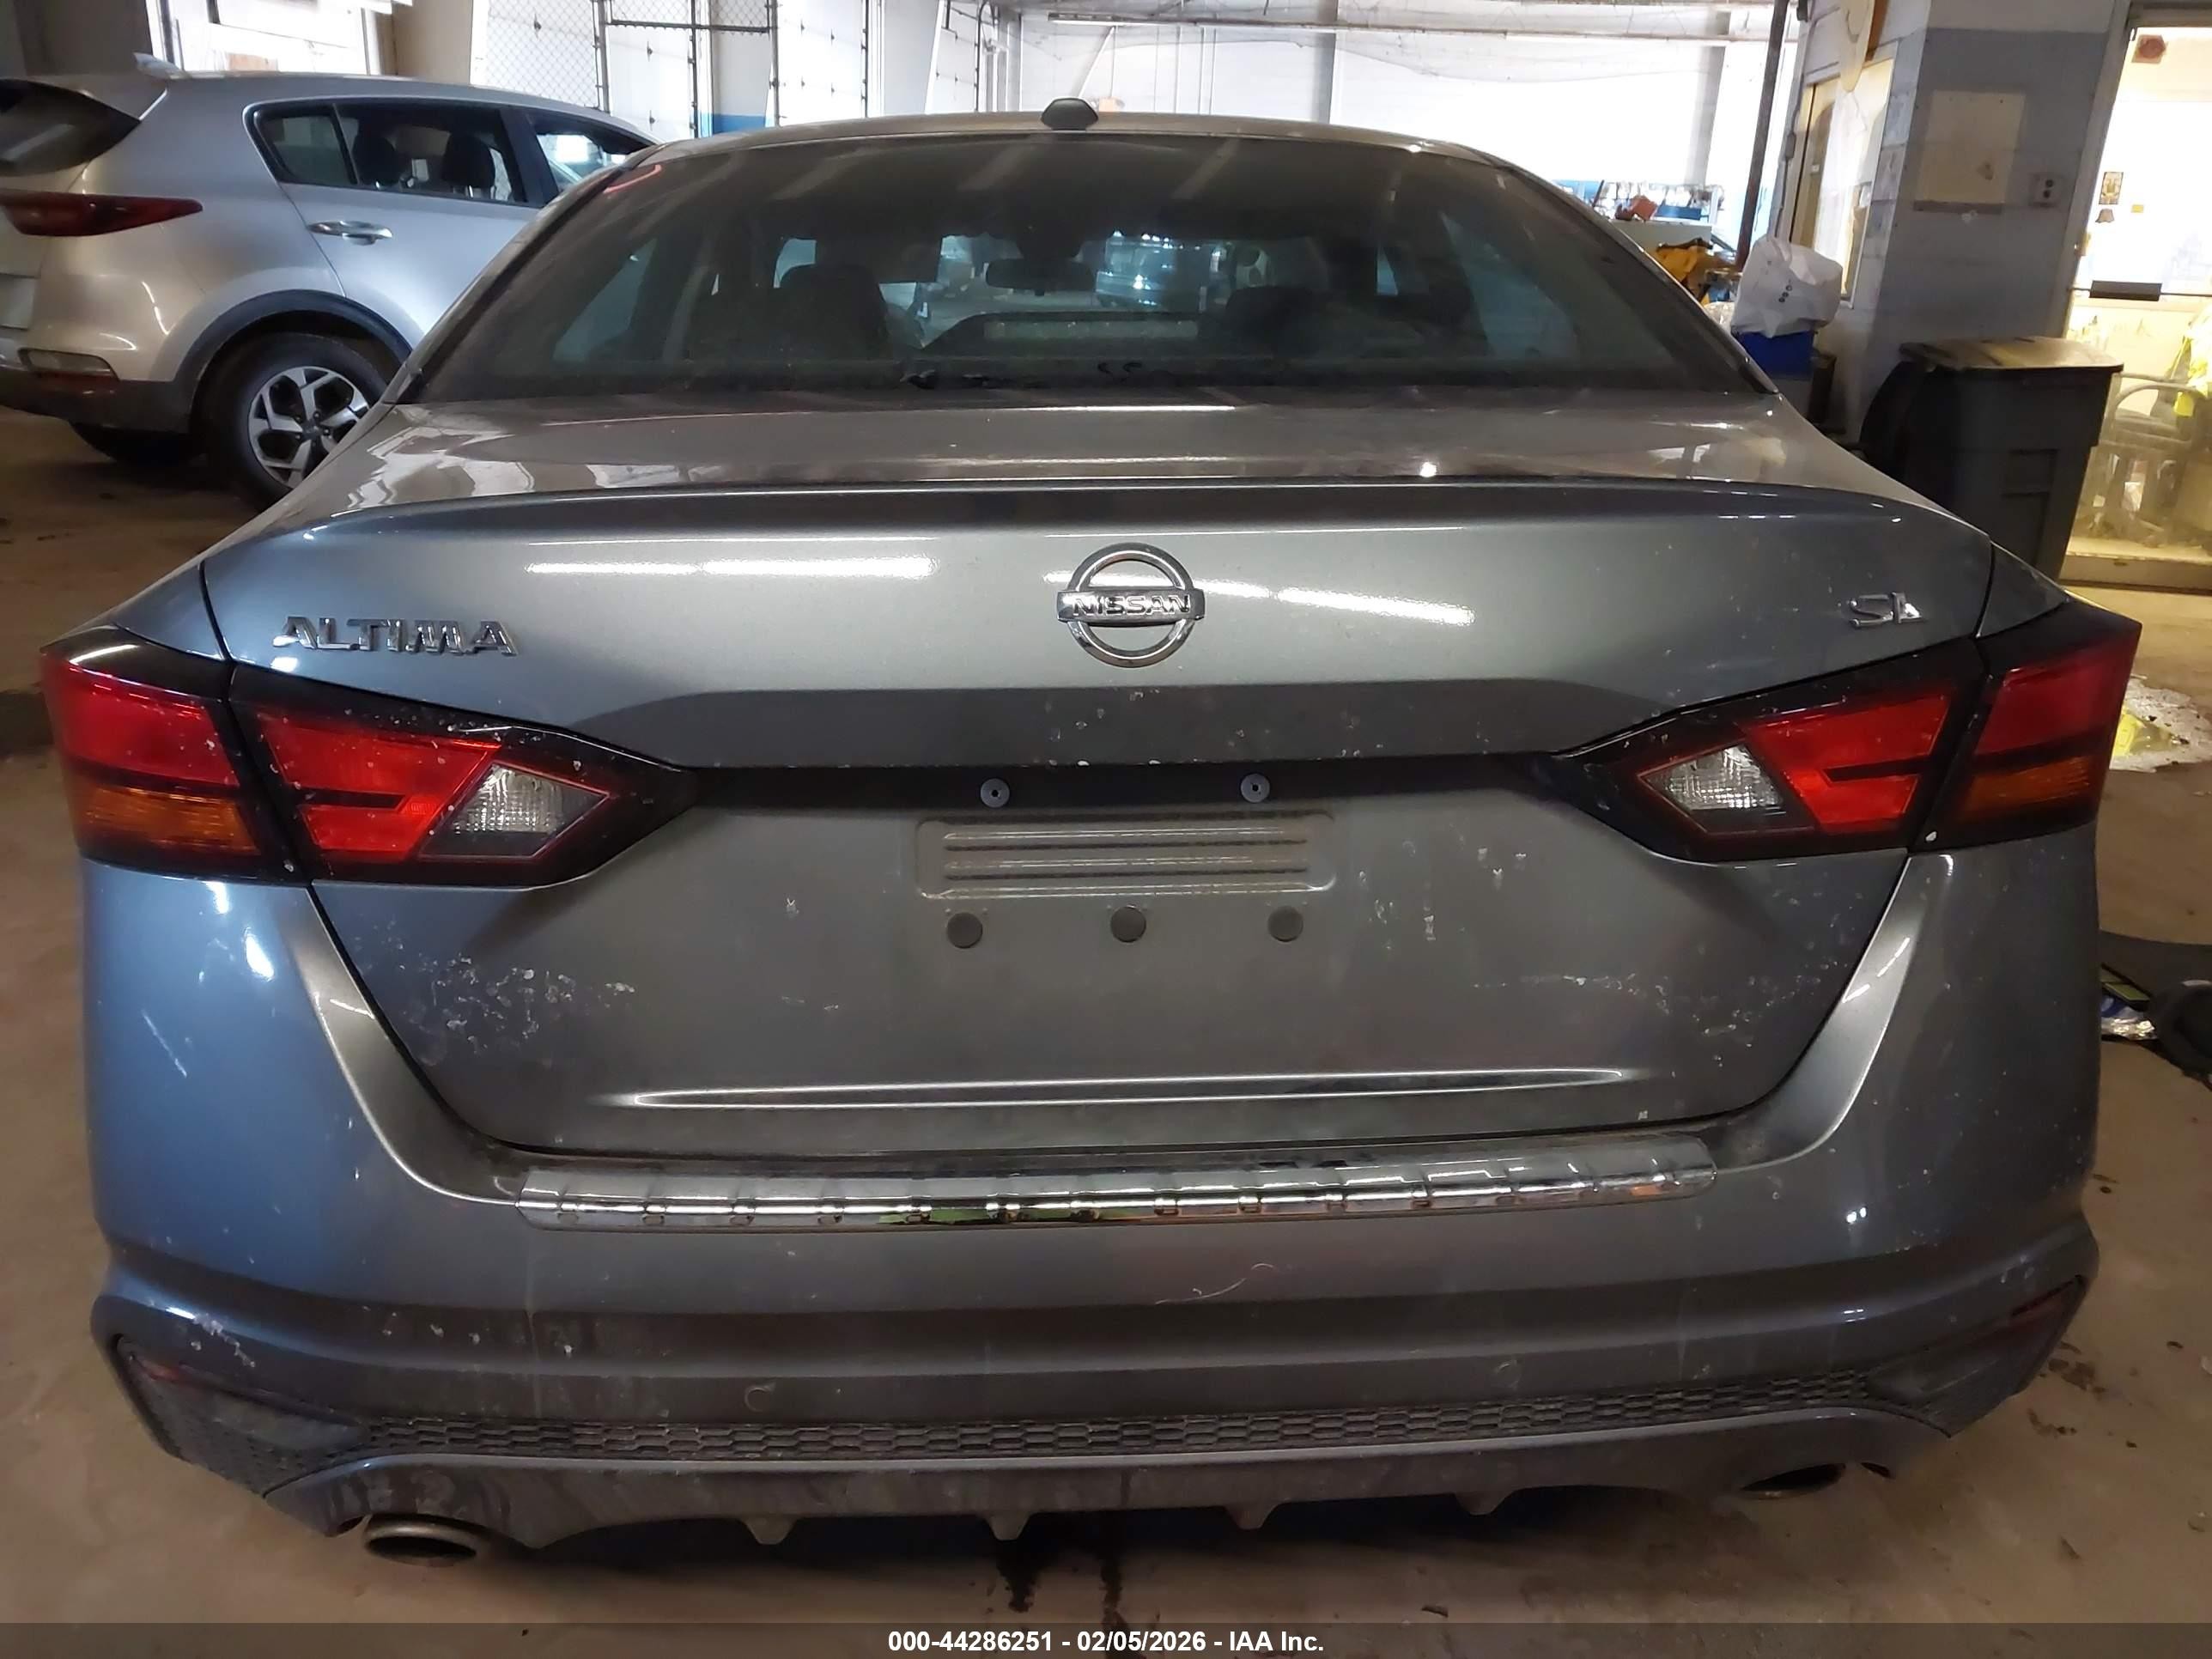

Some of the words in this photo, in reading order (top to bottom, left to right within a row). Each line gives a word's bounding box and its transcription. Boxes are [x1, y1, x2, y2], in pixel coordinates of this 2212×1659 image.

[1073, 594, 1192, 616] NISSAN
[1848, 591, 1926, 628] SL
[272, 616, 520, 657] ALTIMA
